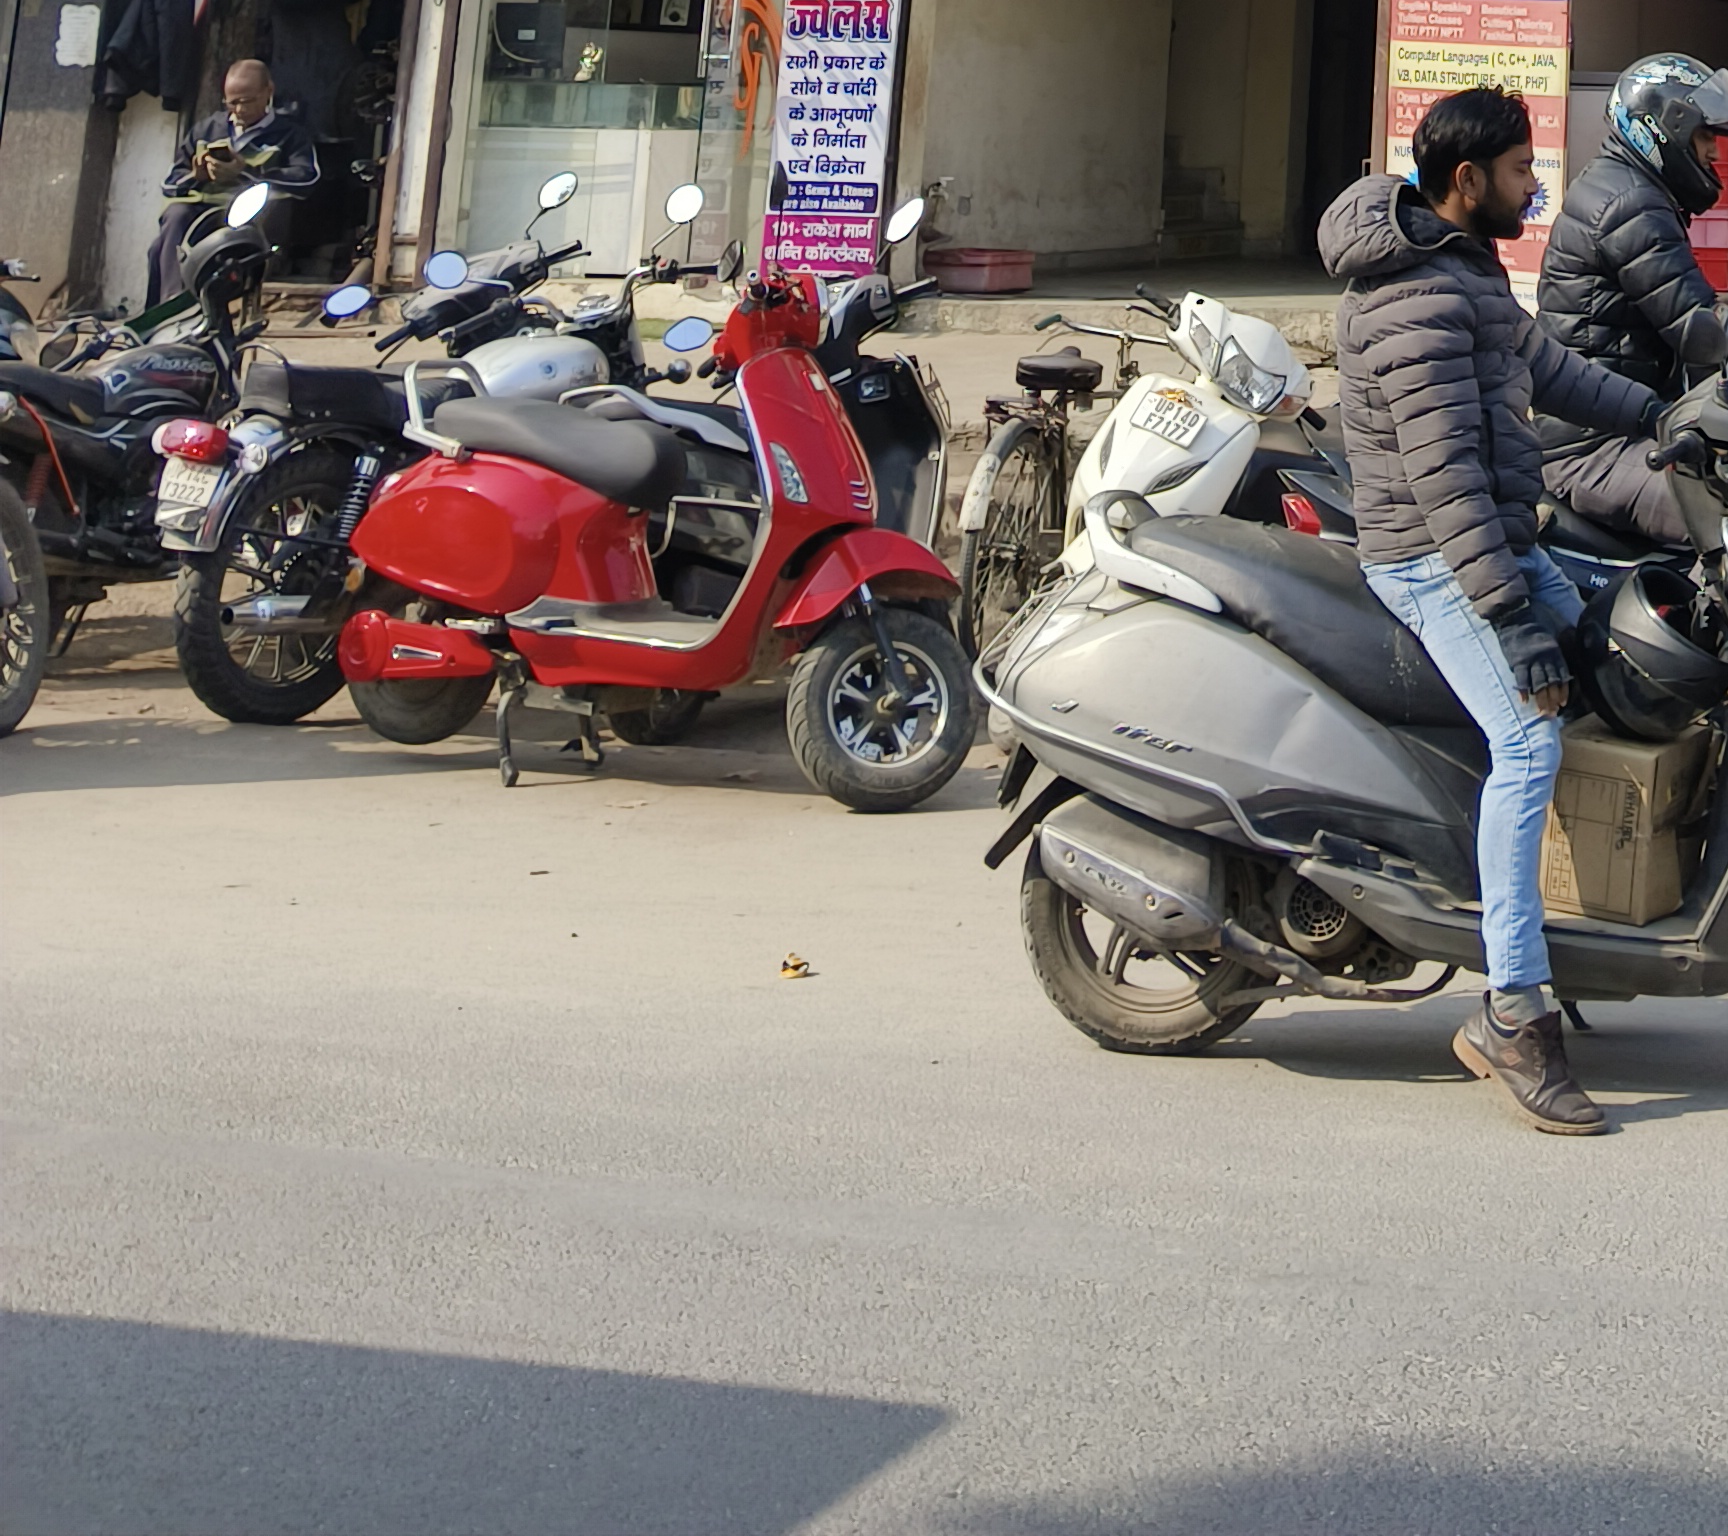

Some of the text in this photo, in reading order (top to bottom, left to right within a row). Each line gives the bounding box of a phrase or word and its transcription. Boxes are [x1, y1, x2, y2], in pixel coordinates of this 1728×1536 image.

[786, 50, 887, 72] सभी प्रकार के
[1143, 412, 1190, 441] F7177
[1154, 397, 1200, 428] UP14D
